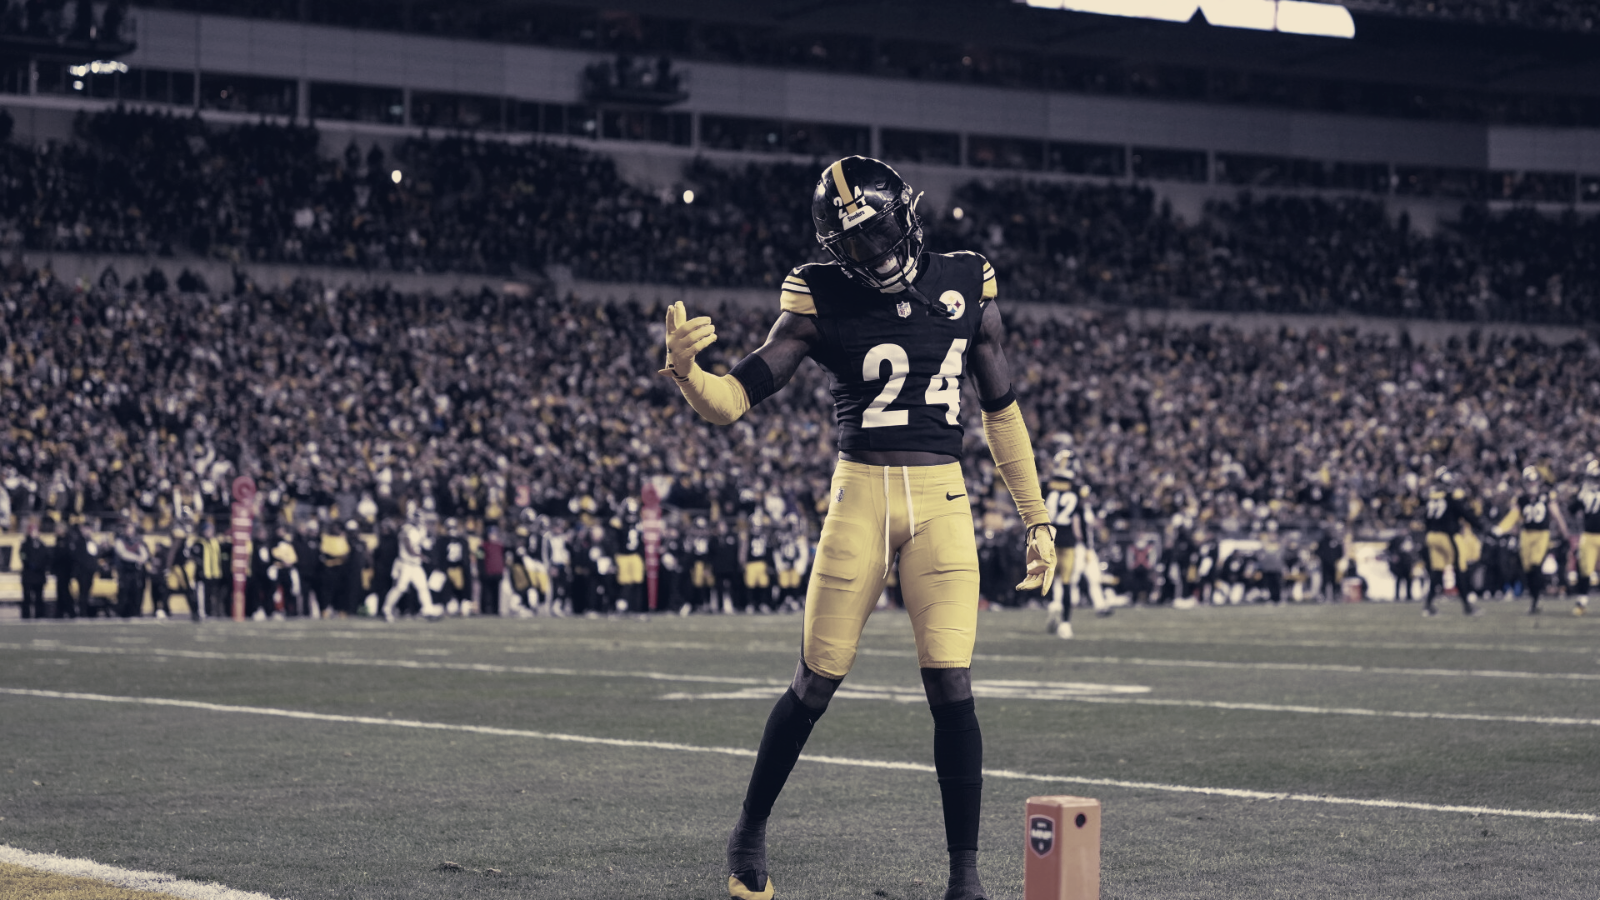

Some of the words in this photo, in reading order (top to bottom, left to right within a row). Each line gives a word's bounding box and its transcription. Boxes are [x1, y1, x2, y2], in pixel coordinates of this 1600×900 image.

[833, 185, 867, 219] 24
[847, 210, 865, 222] Steelers
[861, 338, 968, 428] 24
